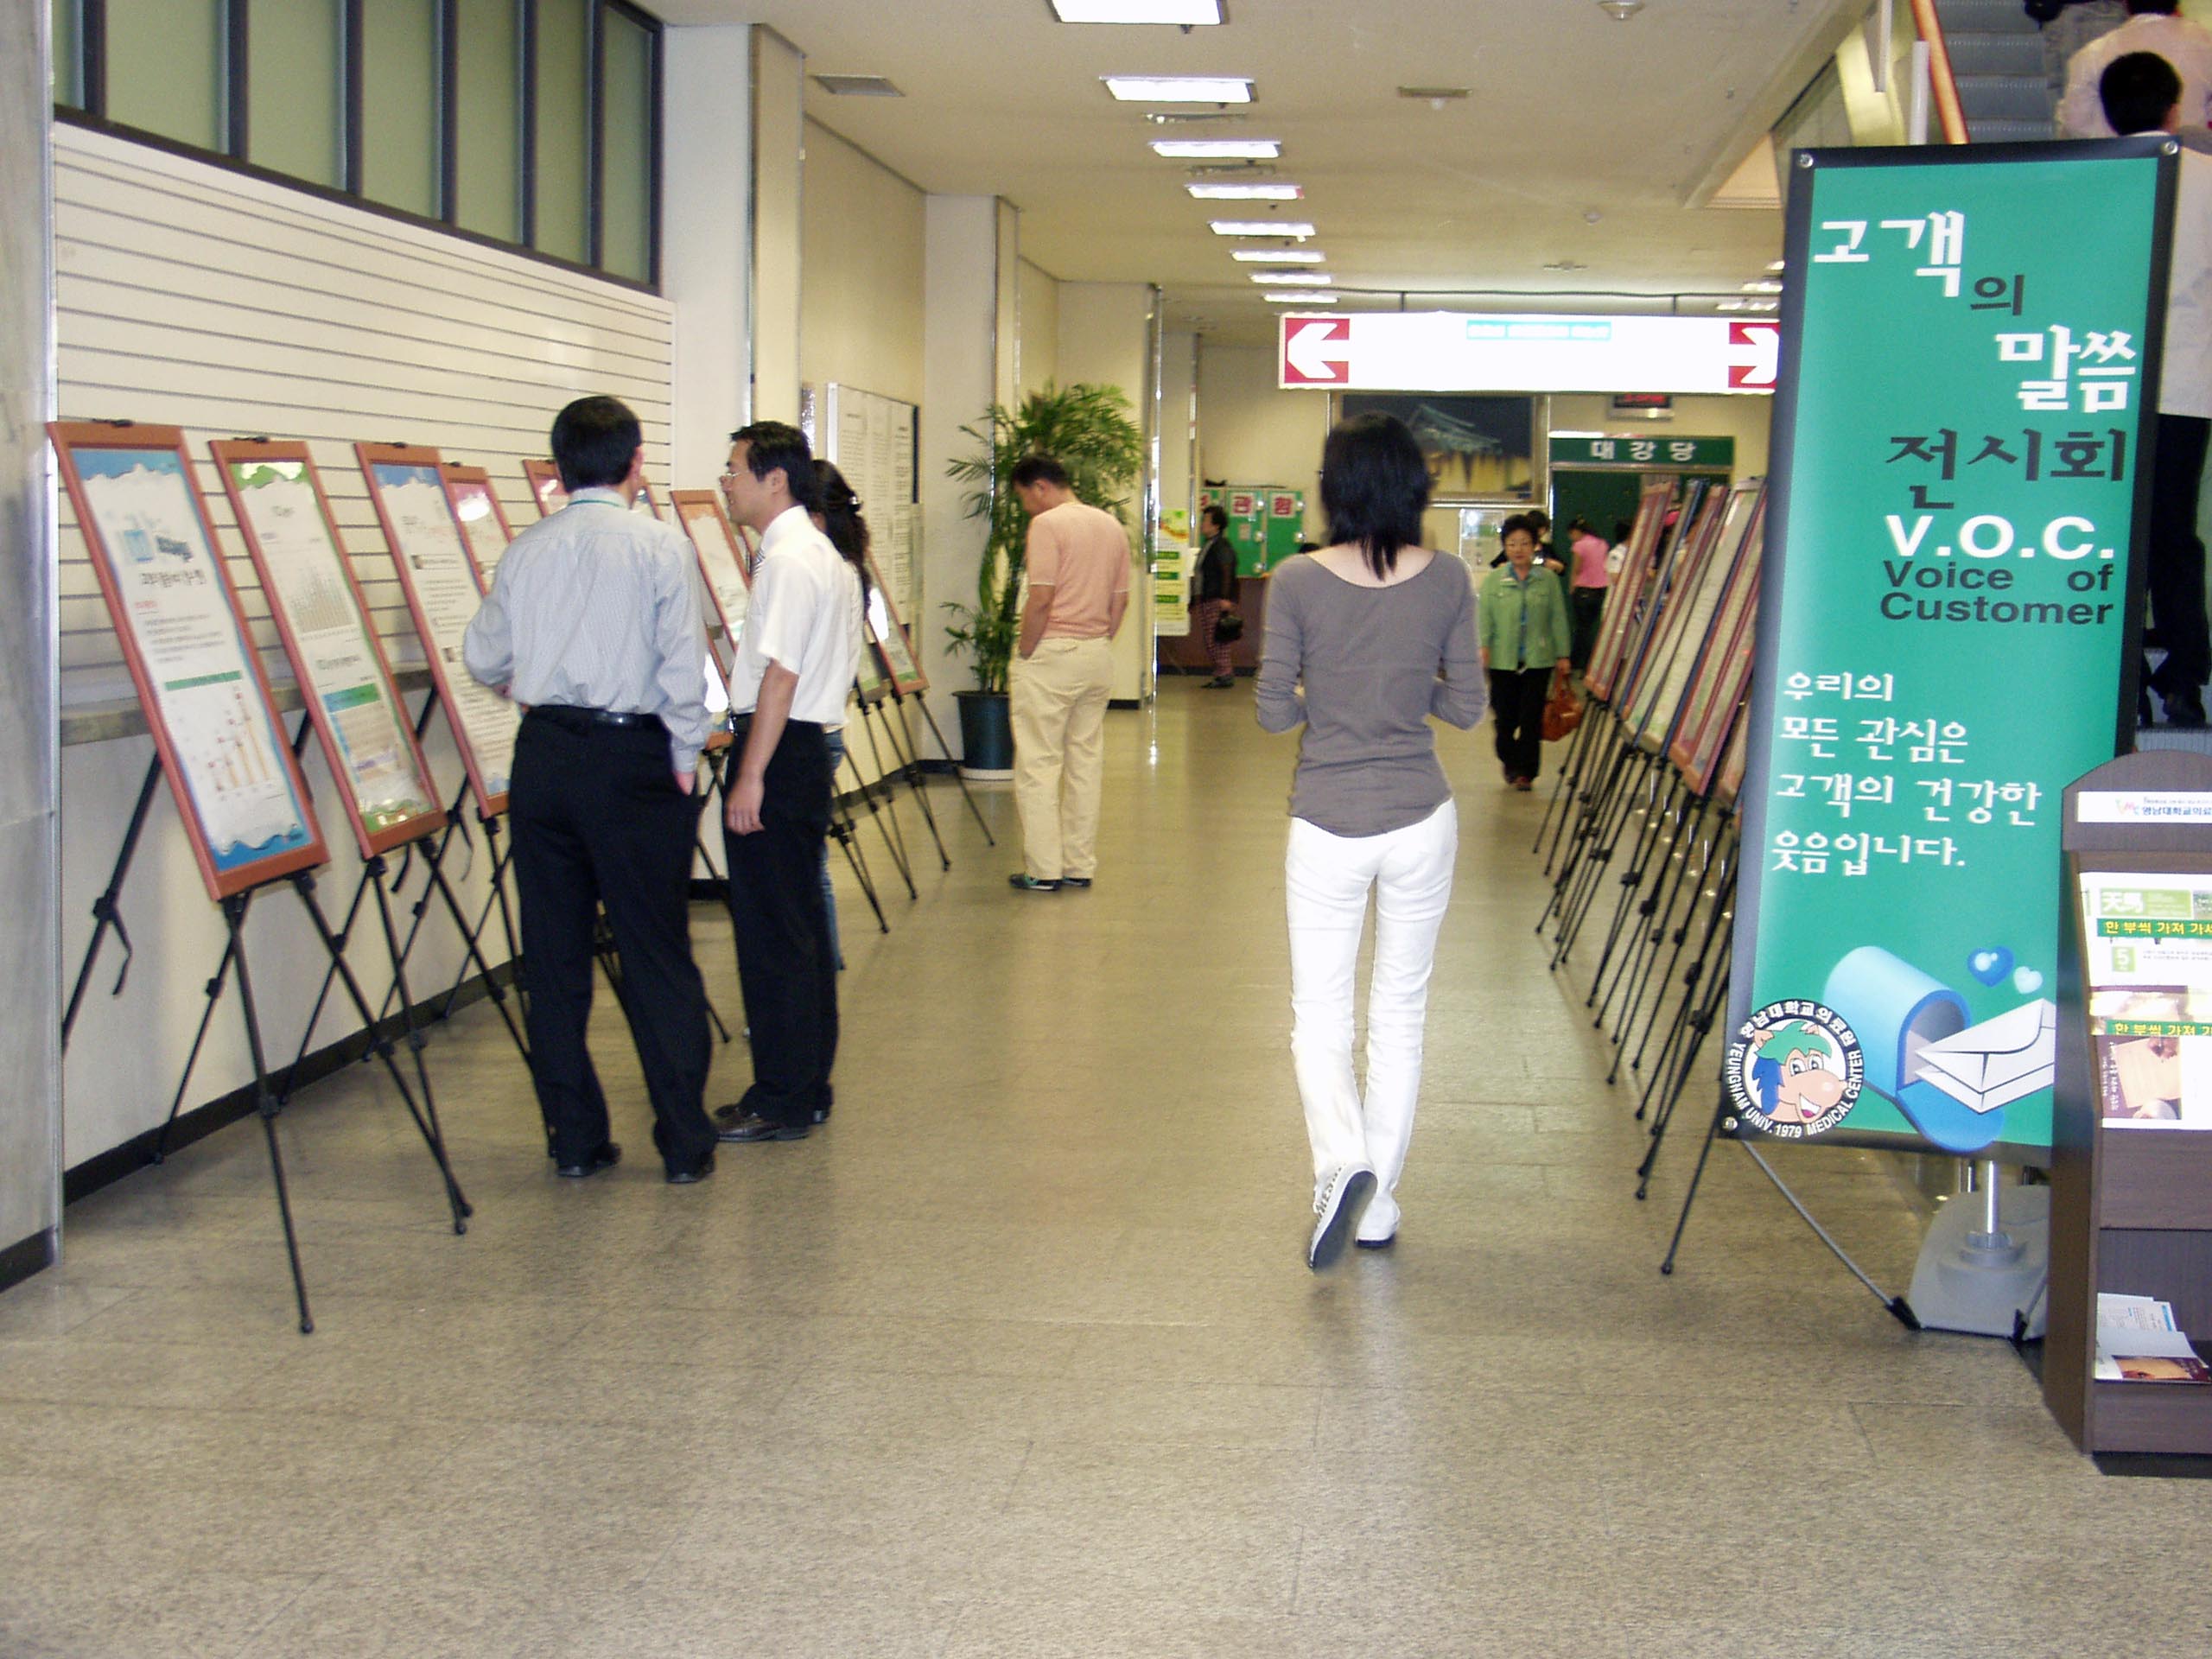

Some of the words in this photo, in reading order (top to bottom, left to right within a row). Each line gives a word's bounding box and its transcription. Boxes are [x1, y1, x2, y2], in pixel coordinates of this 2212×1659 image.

[1994, 324, 2136, 413] 말씀
[1885, 428, 2126, 509] 전시회
[1885, 514, 2114, 560] V.O.C.
[1882, 560, 2014, 590] Voice
[2066, 563, 2114, 592] of
[1879, 591, 2114, 625] Customer
[1783, 671, 1894, 702] 우리의
[1780, 716, 1839, 758] 모든
[1854, 716, 1968, 764] 관심은
[1776, 773, 1894, 818] 고객의
[1915, 778, 2043, 826] 건강한
[1771, 830, 1966, 876] 웃음입니다.
[1739, 1000, 1858, 1047] 영남대학교의료원
[1727, 1042, 1748, 1111] YEUNGNAM
[1745, 1107, 1773, 1135] UNIV.
[1775, 1124, 1802, 1139] 1979
[1806, 1102, 1854, 1136] MEDICAL
[1845, 1049, 1863, 1099] CENTER
